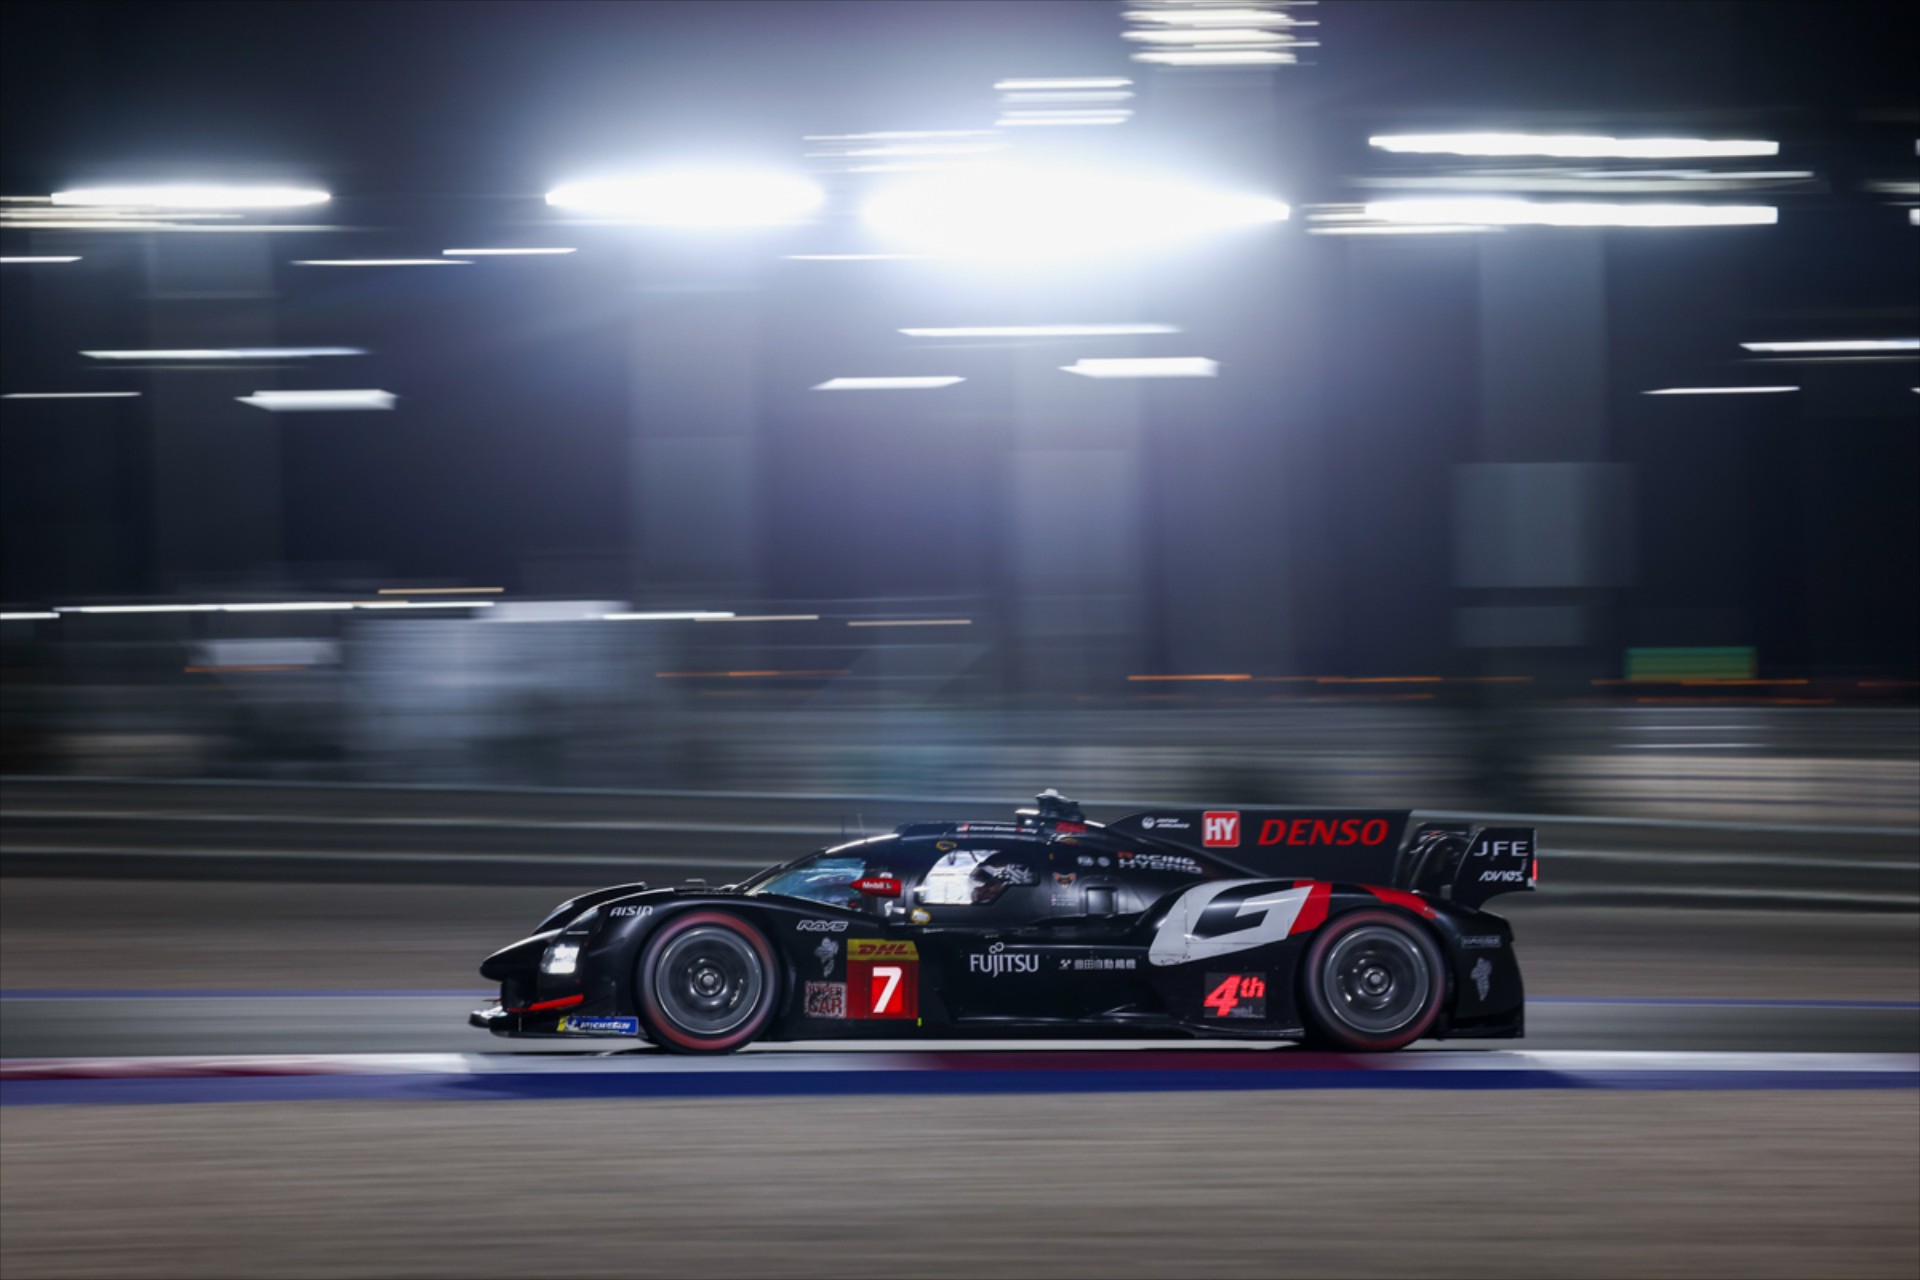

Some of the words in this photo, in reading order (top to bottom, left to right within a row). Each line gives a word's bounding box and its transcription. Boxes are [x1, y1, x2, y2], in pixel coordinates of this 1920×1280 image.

[1203, 817, 1237, 841] HY
[1257, 818, 1390, 846] DENSO
[1473, 840, 1529, 857] JFE
[796, 919, 849, 932] RAYS
[857, 944, 908, 956] DHL
[969, 953, 1040, 978] FUJITSU
[872, 966, 903, 1013] 7
[1202, 974, 1267, 1017] 4th
